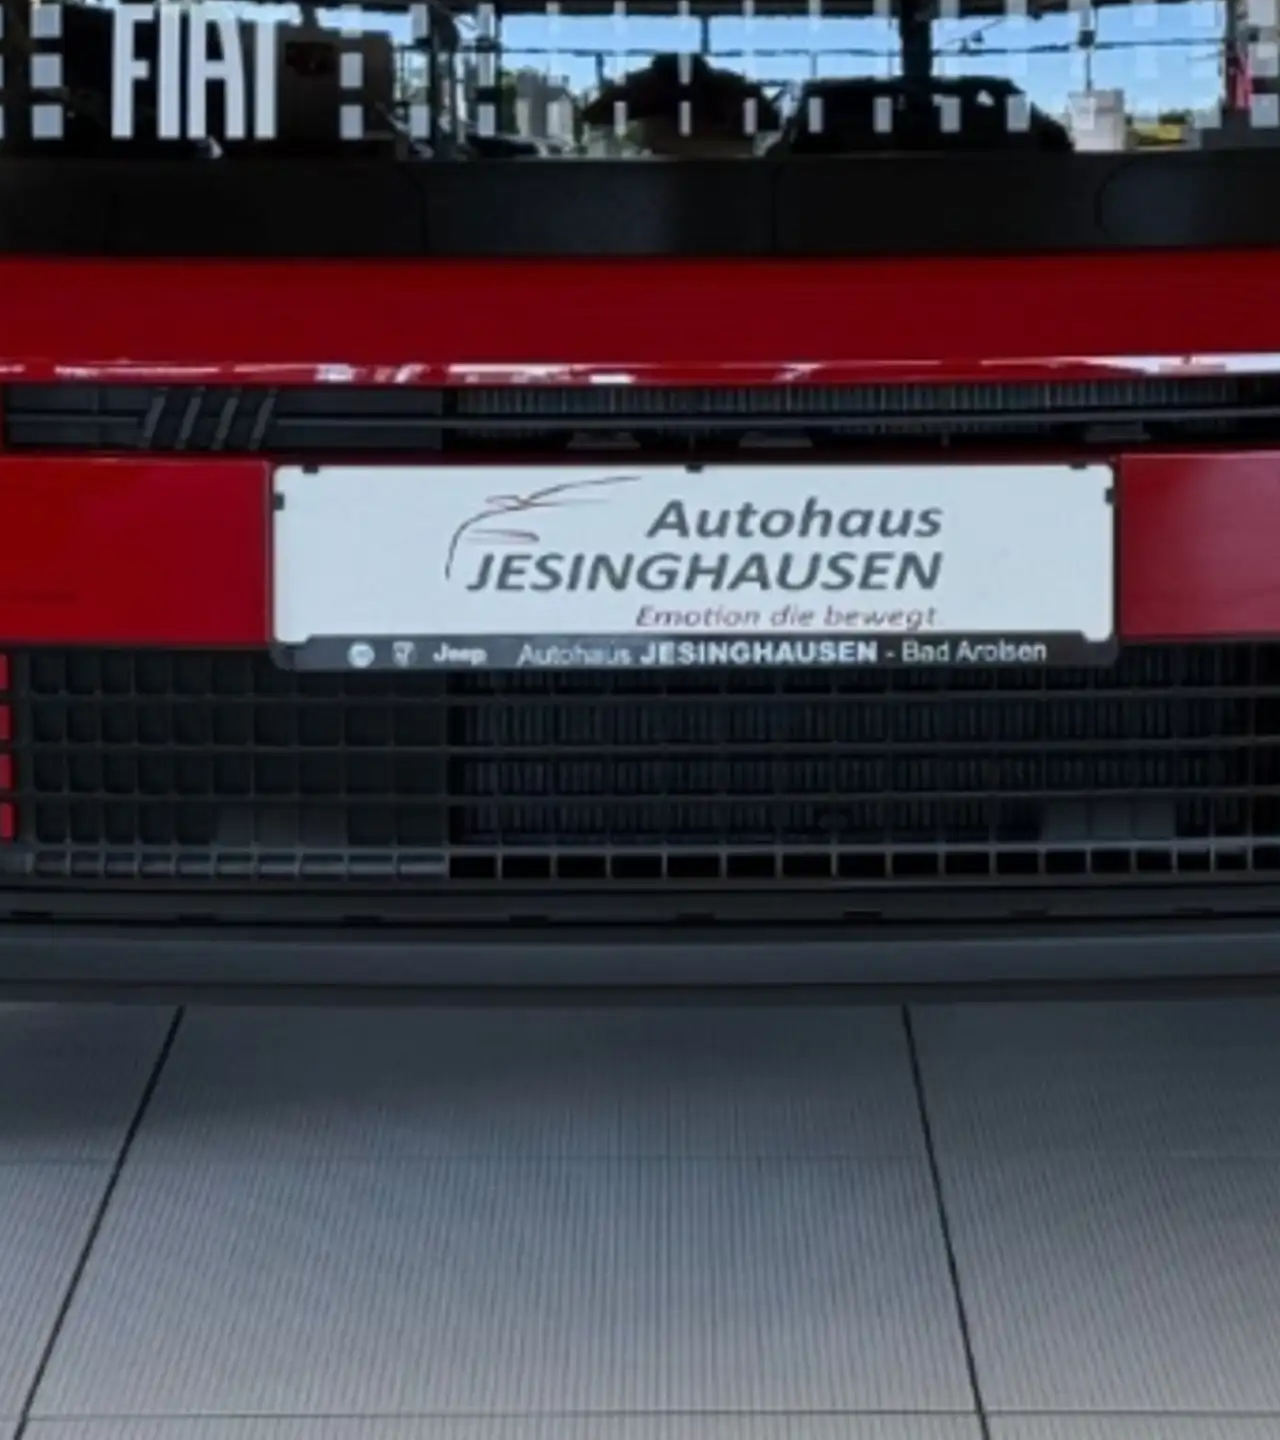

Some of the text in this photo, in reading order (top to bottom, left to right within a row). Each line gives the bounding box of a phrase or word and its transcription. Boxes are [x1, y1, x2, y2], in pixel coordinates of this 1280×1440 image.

[111, 3, 302, 139] FIAT
[646, 496, 943, 538] Autohaus
[465, 550, 943, 591] JESINGHAUSEN
[635, 605, 761, 628] Emotion
[770, 604, 814, 628] die
[433, 641, 487, 666] Jeep
[517, 642, 630, 666] Autohaus
[640, 641, 878, 666] JESINGHAUSEN
[902, 640, 949, 661] Bad
[958, 639, 1047, 662] Arolsen
